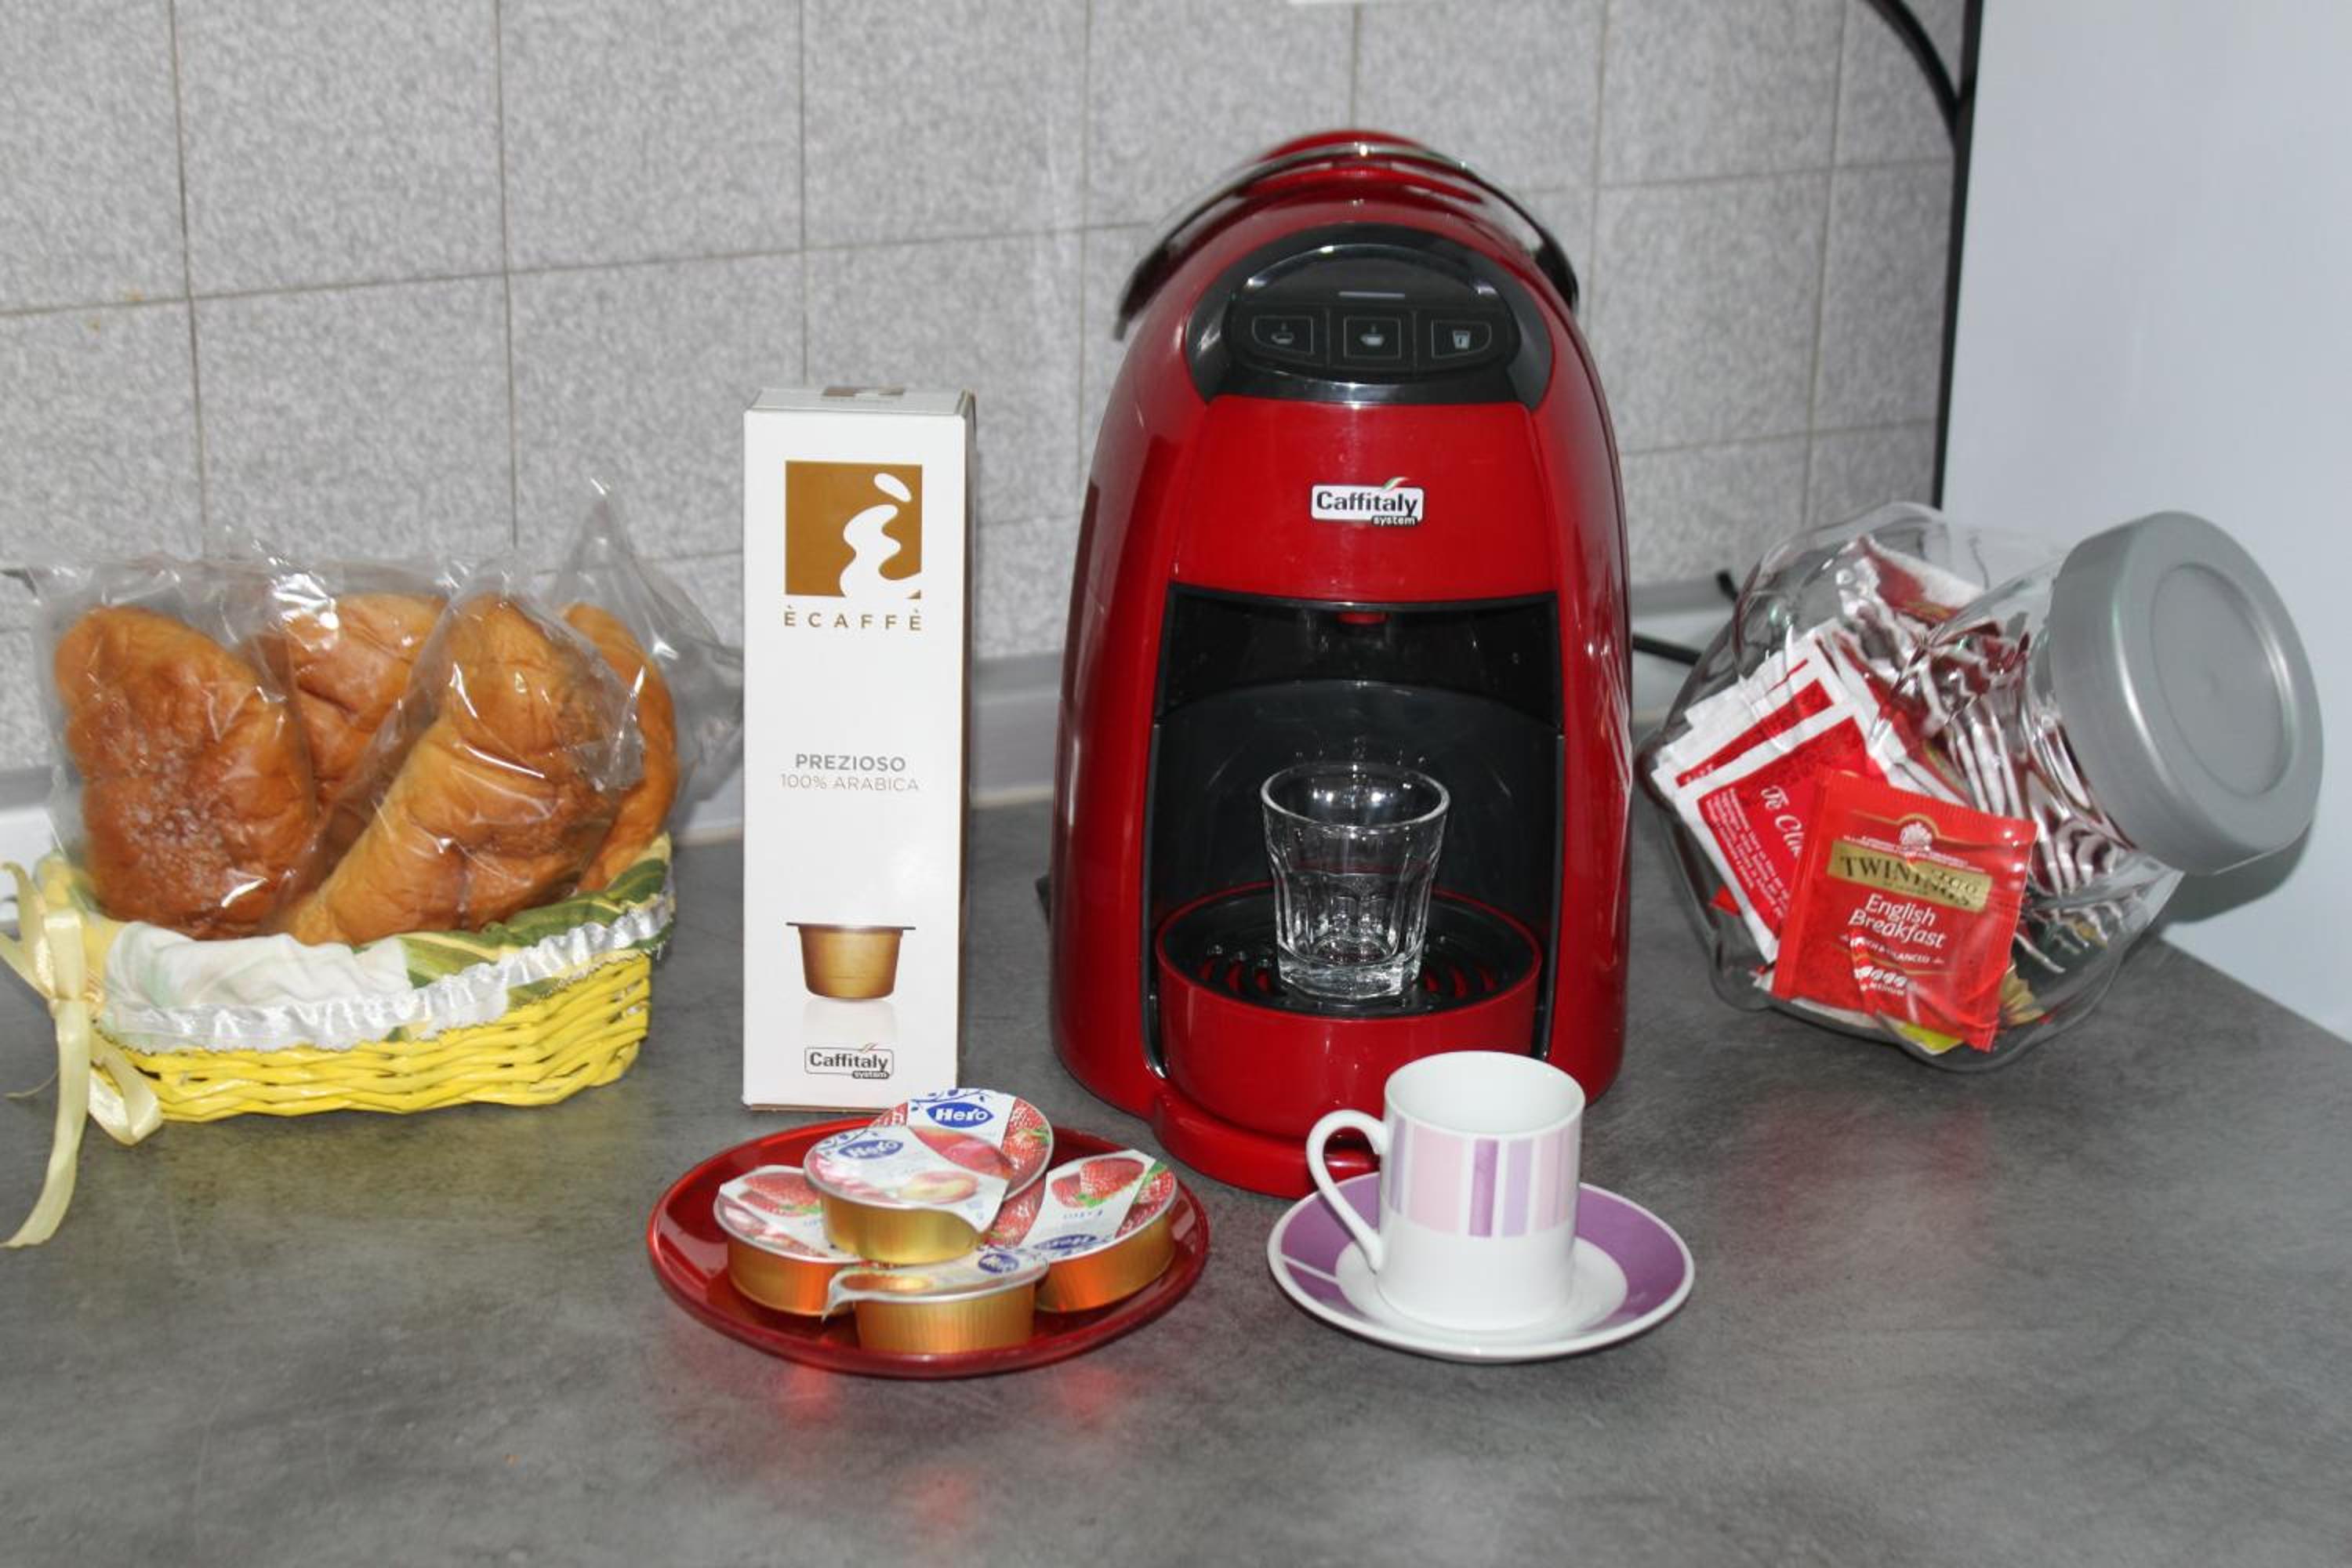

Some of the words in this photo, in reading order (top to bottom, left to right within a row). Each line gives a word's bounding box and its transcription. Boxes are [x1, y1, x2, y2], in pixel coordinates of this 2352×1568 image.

[1316, 491, 1418, 517] Caffitaly
[1373, 517, 1416, 526] system
[795, 753, 906, 772] PREZIOSO
[781, 774, 827, 789] 100%
[833, 776, 919, 791] ARABICA
[1864, 893, 1936, 927] English
[1848, 908, 1947, 949] Breakfast
[810, 1051, 888, 1073] Caffitaly
[935, 1108, 988, 1121] Hero
